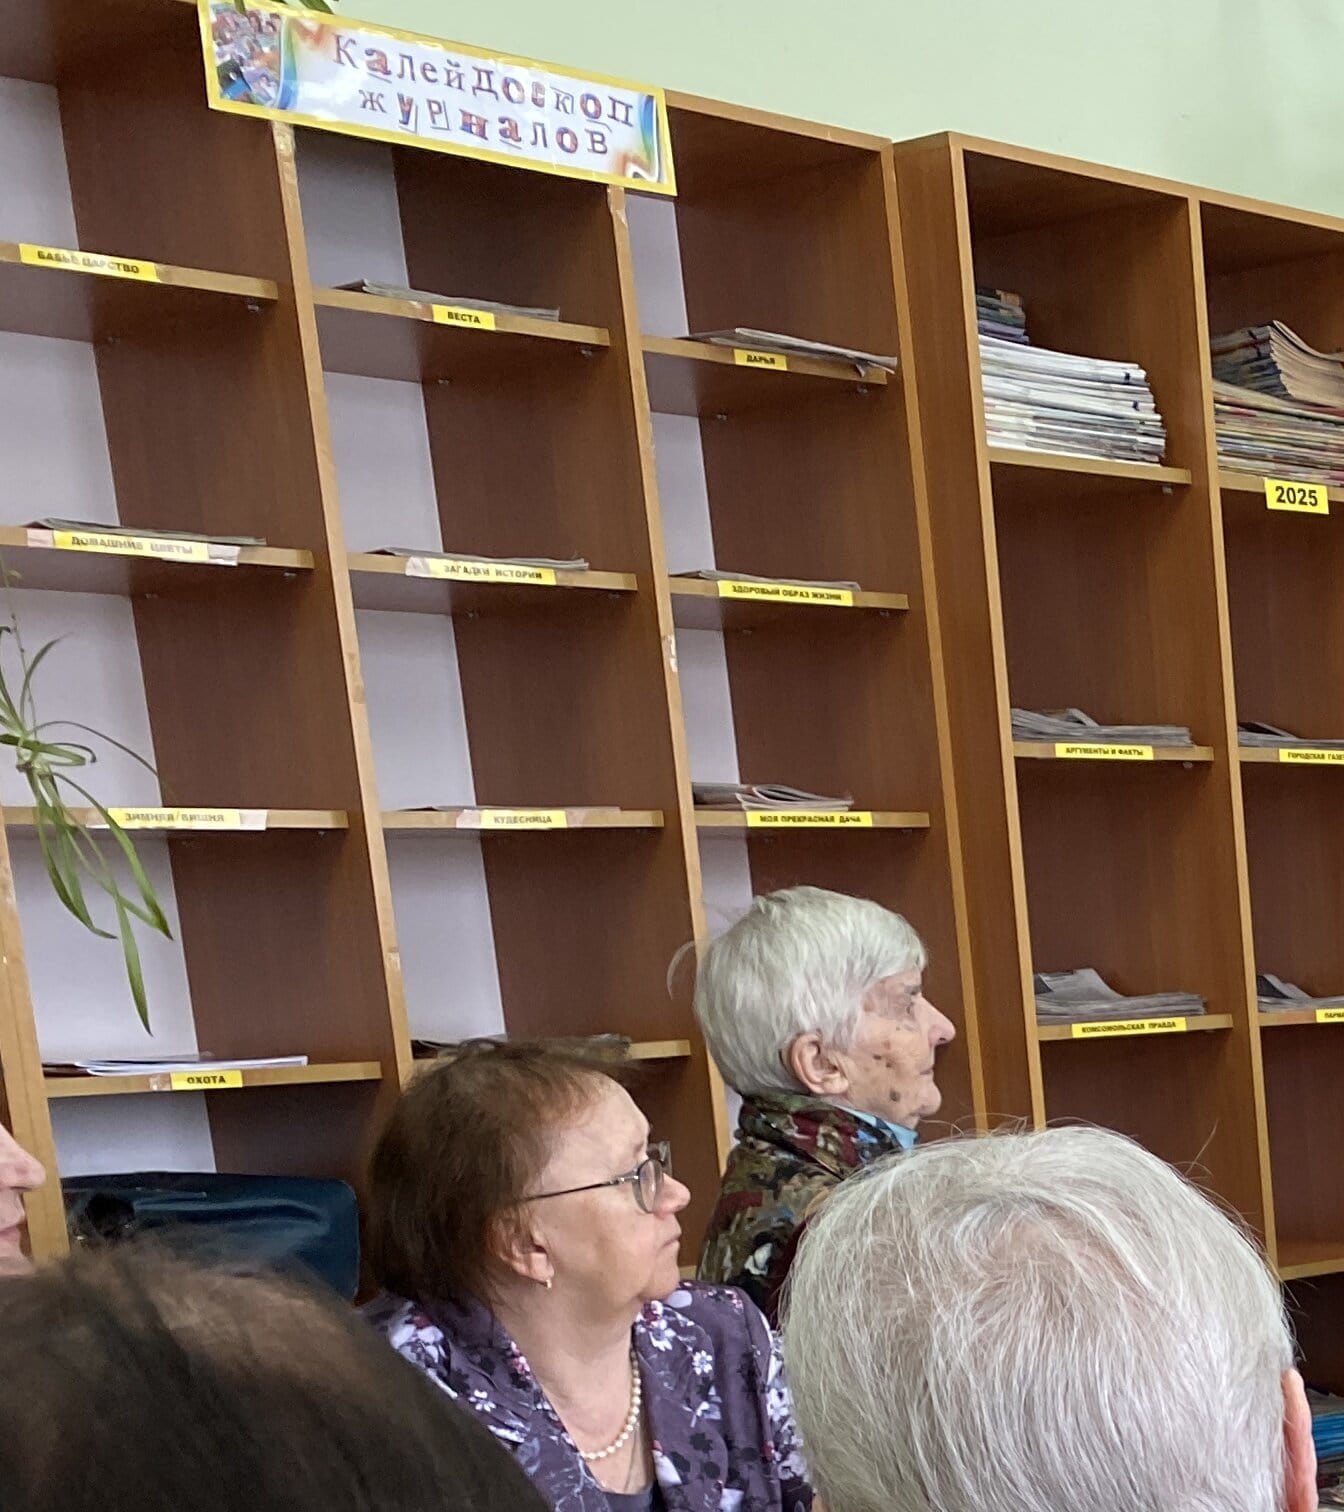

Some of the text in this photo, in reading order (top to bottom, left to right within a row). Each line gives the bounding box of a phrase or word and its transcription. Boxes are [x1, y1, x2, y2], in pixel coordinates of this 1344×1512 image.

[358, 88, 610, 156] журналов
[81, 257, 140, 274] ЦАРСТВО
[447, 311, 481, 324] ВЕСТА
[1275, 485, 1318, 507] 2025
[443, 565, 543, 580] ЗАГАДКИ ИСТОРИИ
[732, 584, 780, 596] ЗДОРОВЫЙ
[782, 589, 810, 599] ОБРАЗ
[493, 815, 553, 825] КУДЕСНИЦА
[759, 815, 779, 823] МОЯ
[839, 815, 862, 824] ДАЧА
[1148, 1020, 1177, 1030] ПРАВДА
[186, 1075, 227, 1085] ОХОТА
